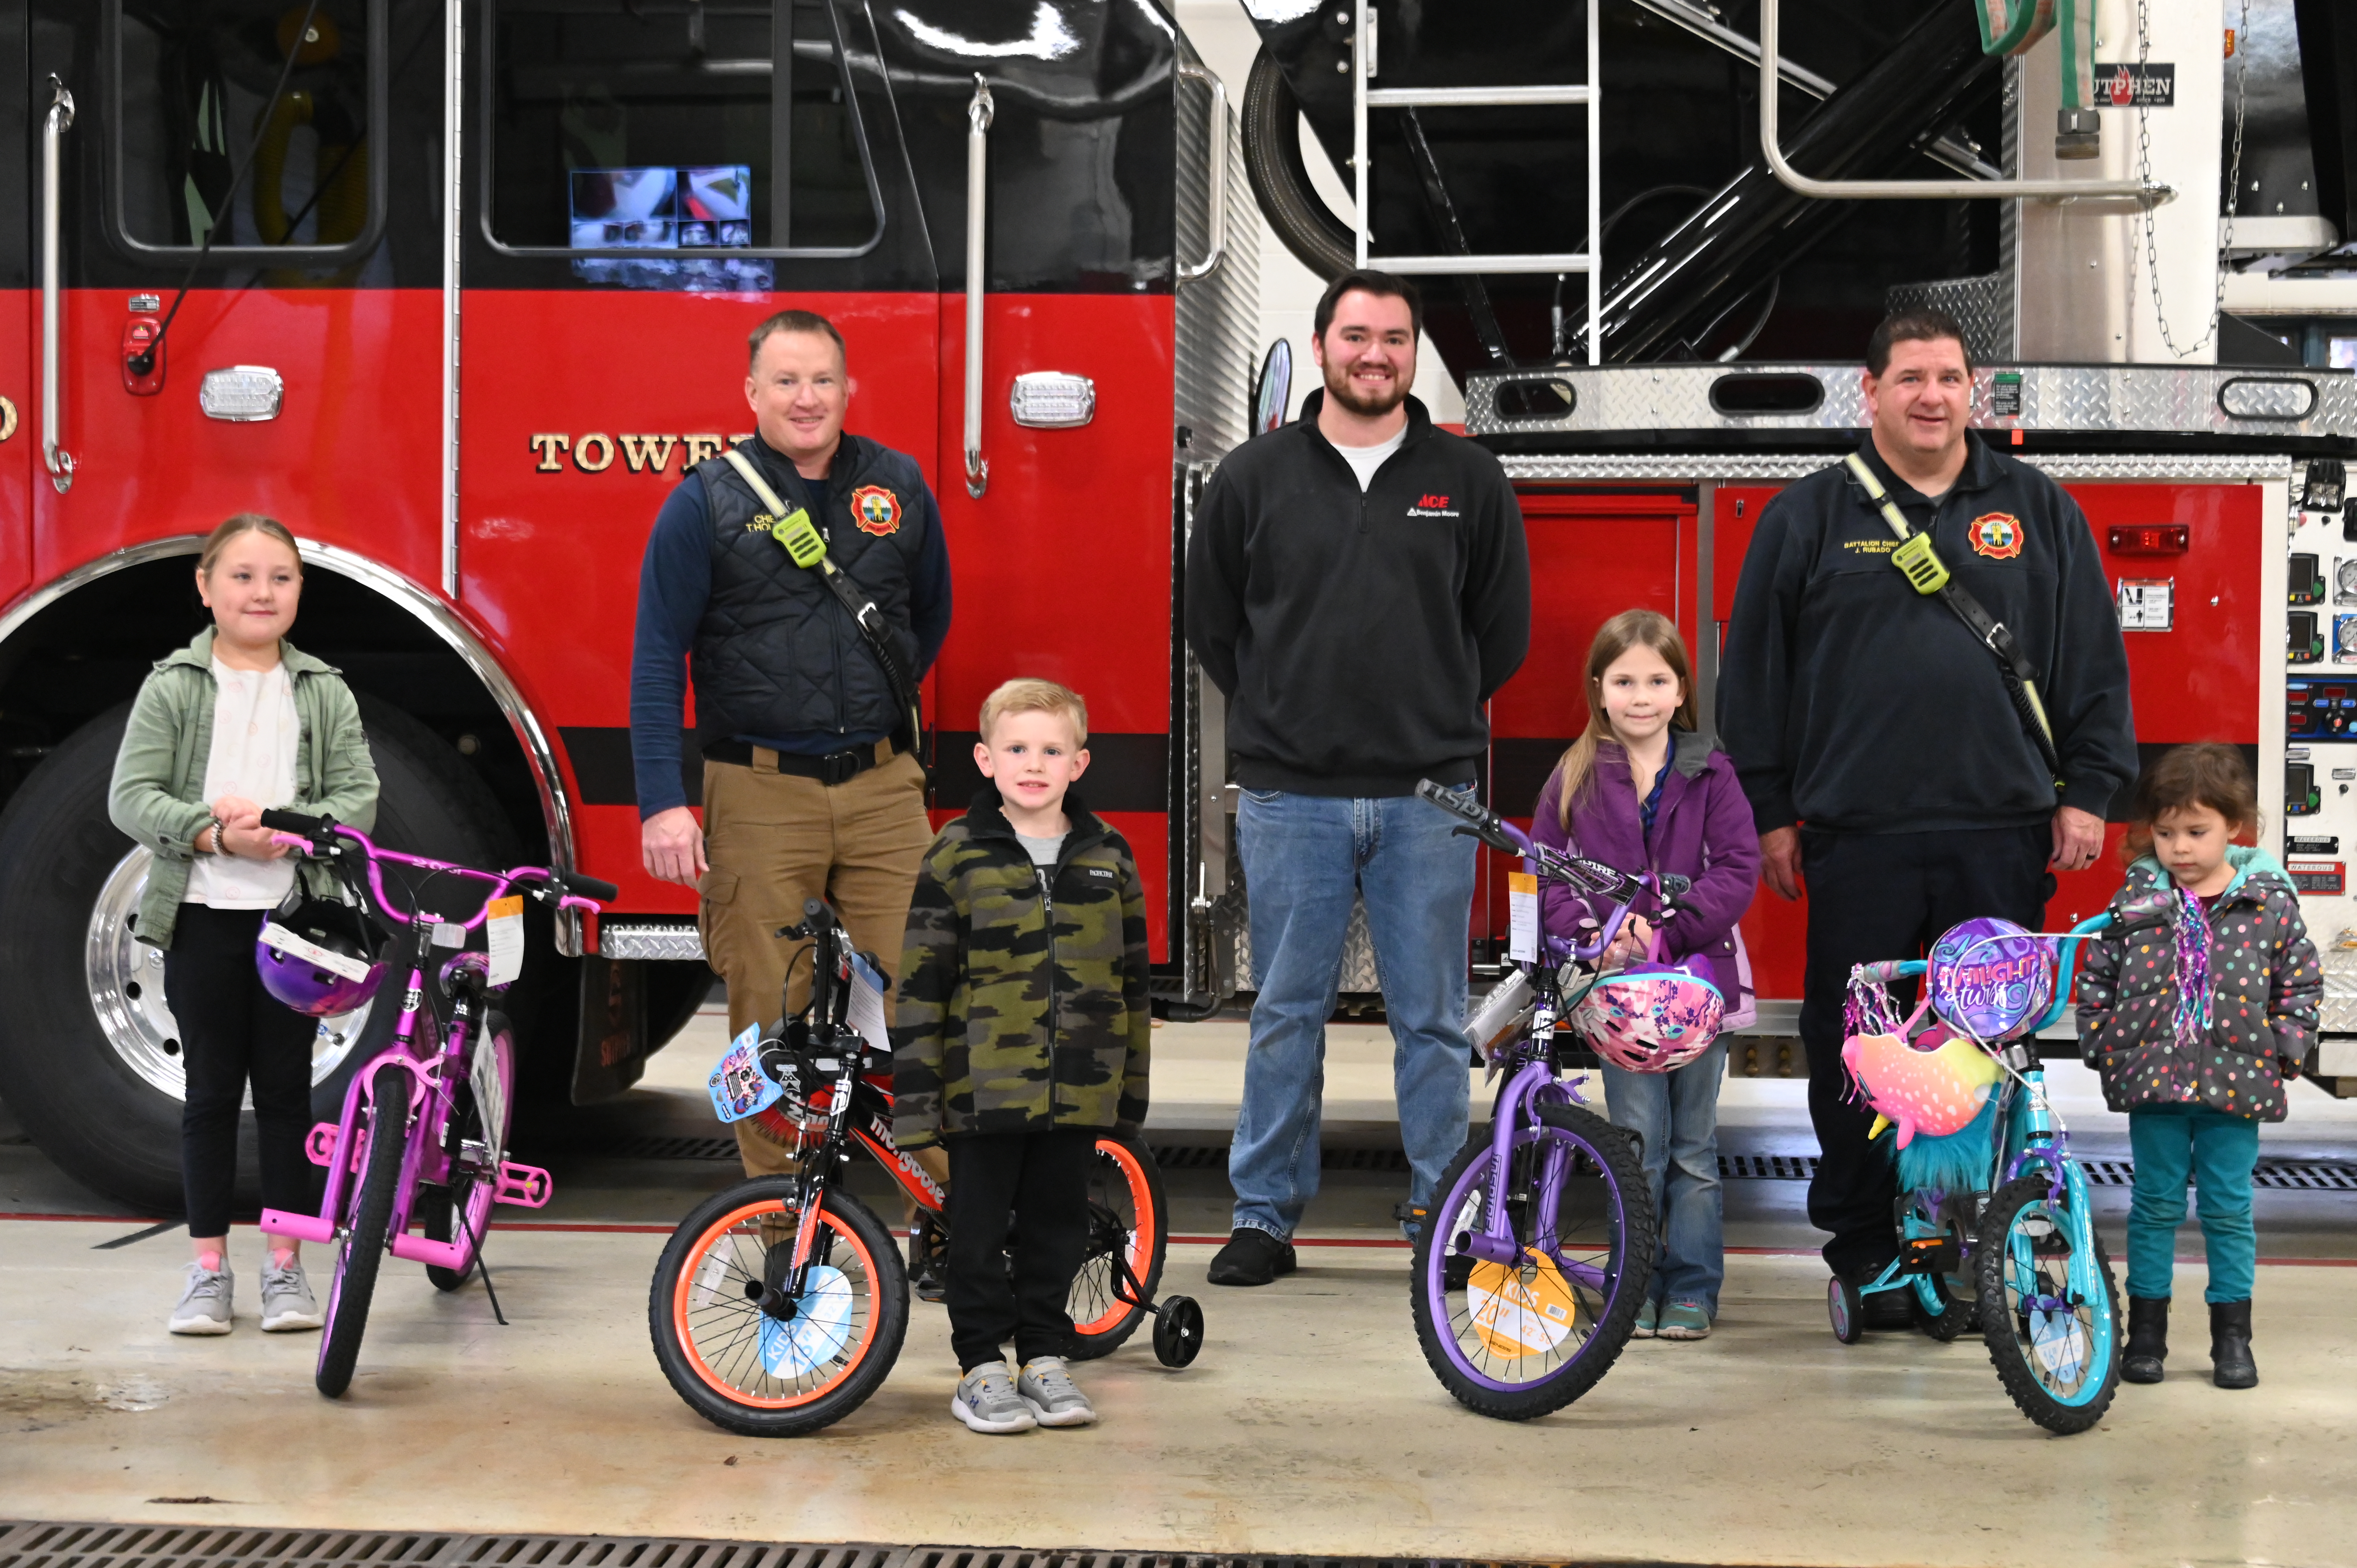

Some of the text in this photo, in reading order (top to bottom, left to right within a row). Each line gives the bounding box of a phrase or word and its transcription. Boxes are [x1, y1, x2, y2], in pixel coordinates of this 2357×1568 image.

[530, 433, 755, 473] TOWE
[1418, 494, 1449, 508] ACE
[754, 514, 776, 524] CHIE
[1844, 540, 1880, 549] BATTALION
[1937, 955, 2036, 992] TWILIGHT
[1485, 1152, 1501, 1232] INSPIRE
[1504, 1280, 1540, 1308] KIDS
[766, 1323, 797, 1361] KIDS
